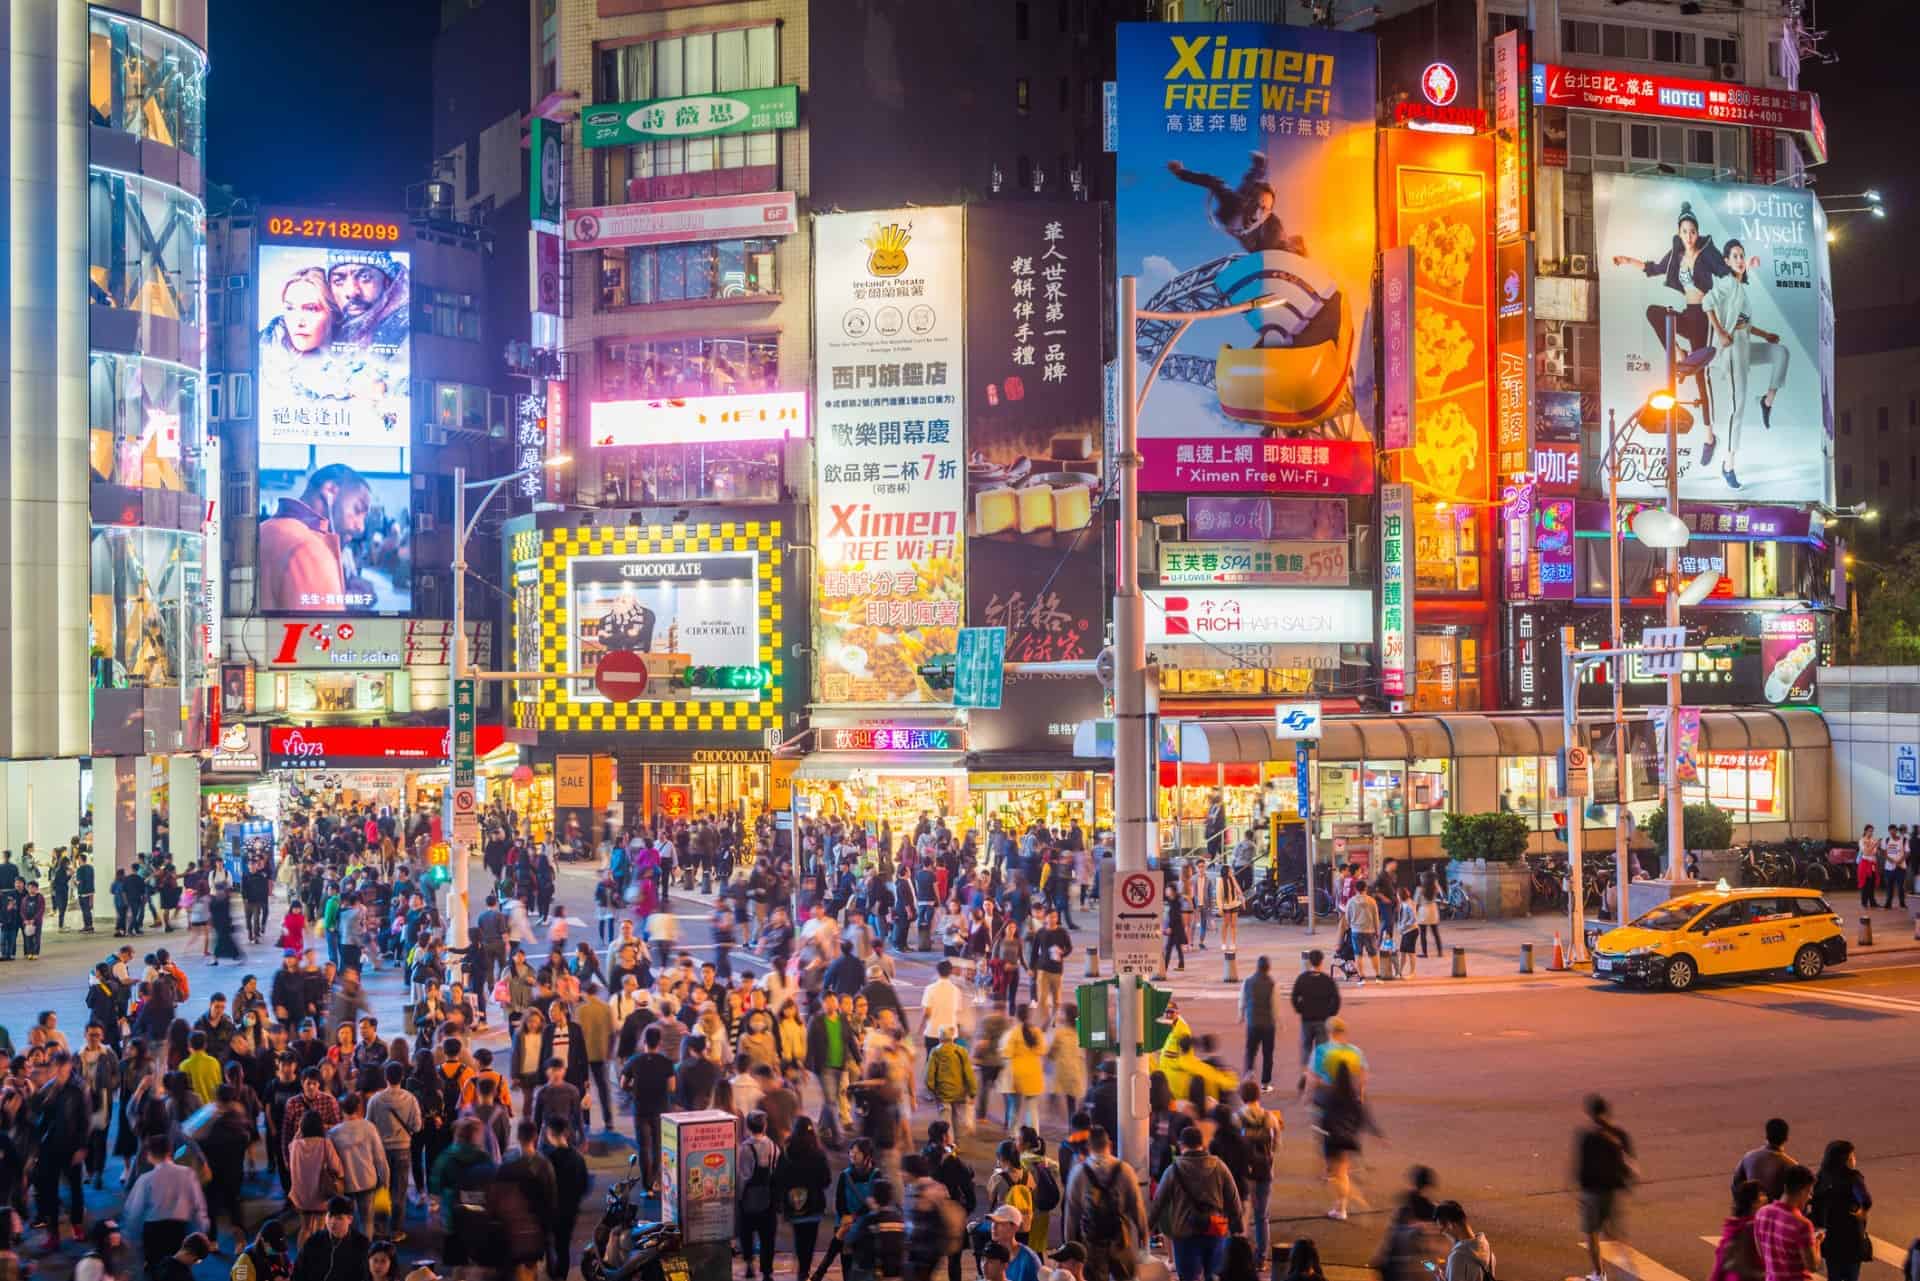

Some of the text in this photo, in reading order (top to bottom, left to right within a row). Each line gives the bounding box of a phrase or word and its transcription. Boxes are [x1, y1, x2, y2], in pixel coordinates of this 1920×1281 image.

[1164, 36, 1335, 86] Ximen
[1164, 84, 1330, 116] FREE Wi-Fi
[1660, 89, 1703, 107] HOTEL
[1166, 113, 1248, 133] 高速奔馳
[767, 208, 783, 220] 6F
[269, 218, 399, 241] 02-27182099
[1741, 218, 1807, 249] Myself
[895, 278, 925, 287] Potato
[1041, 221, 1069, 384] 華人世界第一品牌
[519, 396, 546, 497] 我就厲害
[824, 454, 958, 483] 飲品第二杯7折
[1246, 469, 1277, 483] Free
[827, 504, 958, 537] Ximen
[896, 539, 954, 561] Wi-Fi
[1166, 553, 1219, 572] 玉芙蓉
[1221, 555, 1251, 570] SPA
[1384, 565, 1401, 580] SPA
[1196, 618, 1240, 631] RICH
[1241, 617, 1278, 631] HAIR
[331, 651, 399, 663] hair salon
[835, 729, 949, 749] 歡迎參觀試吃
[561, 776, 584, 788] SALE
